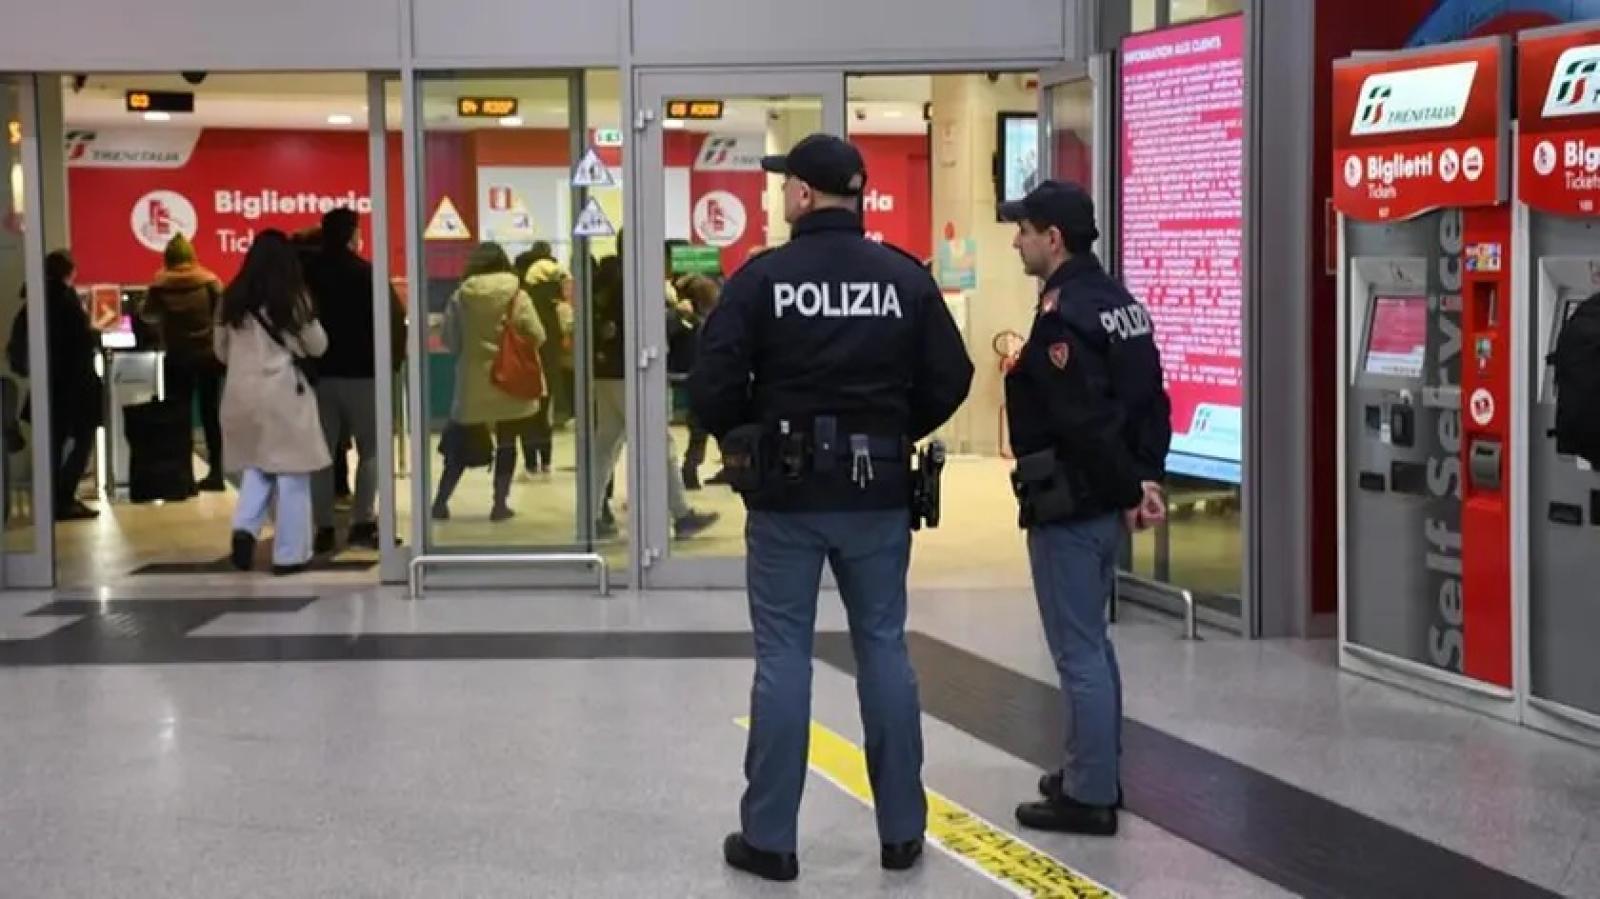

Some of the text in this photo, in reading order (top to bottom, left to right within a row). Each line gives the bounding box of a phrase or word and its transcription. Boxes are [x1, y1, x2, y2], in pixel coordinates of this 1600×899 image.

[1387, 105, 1457, 123] TRENITALIA
[1366, 152, 1434, 185] Biglietti
[773, 281, 903, 319] POLIZIA
[1423, 516, 1464, 674] Self
